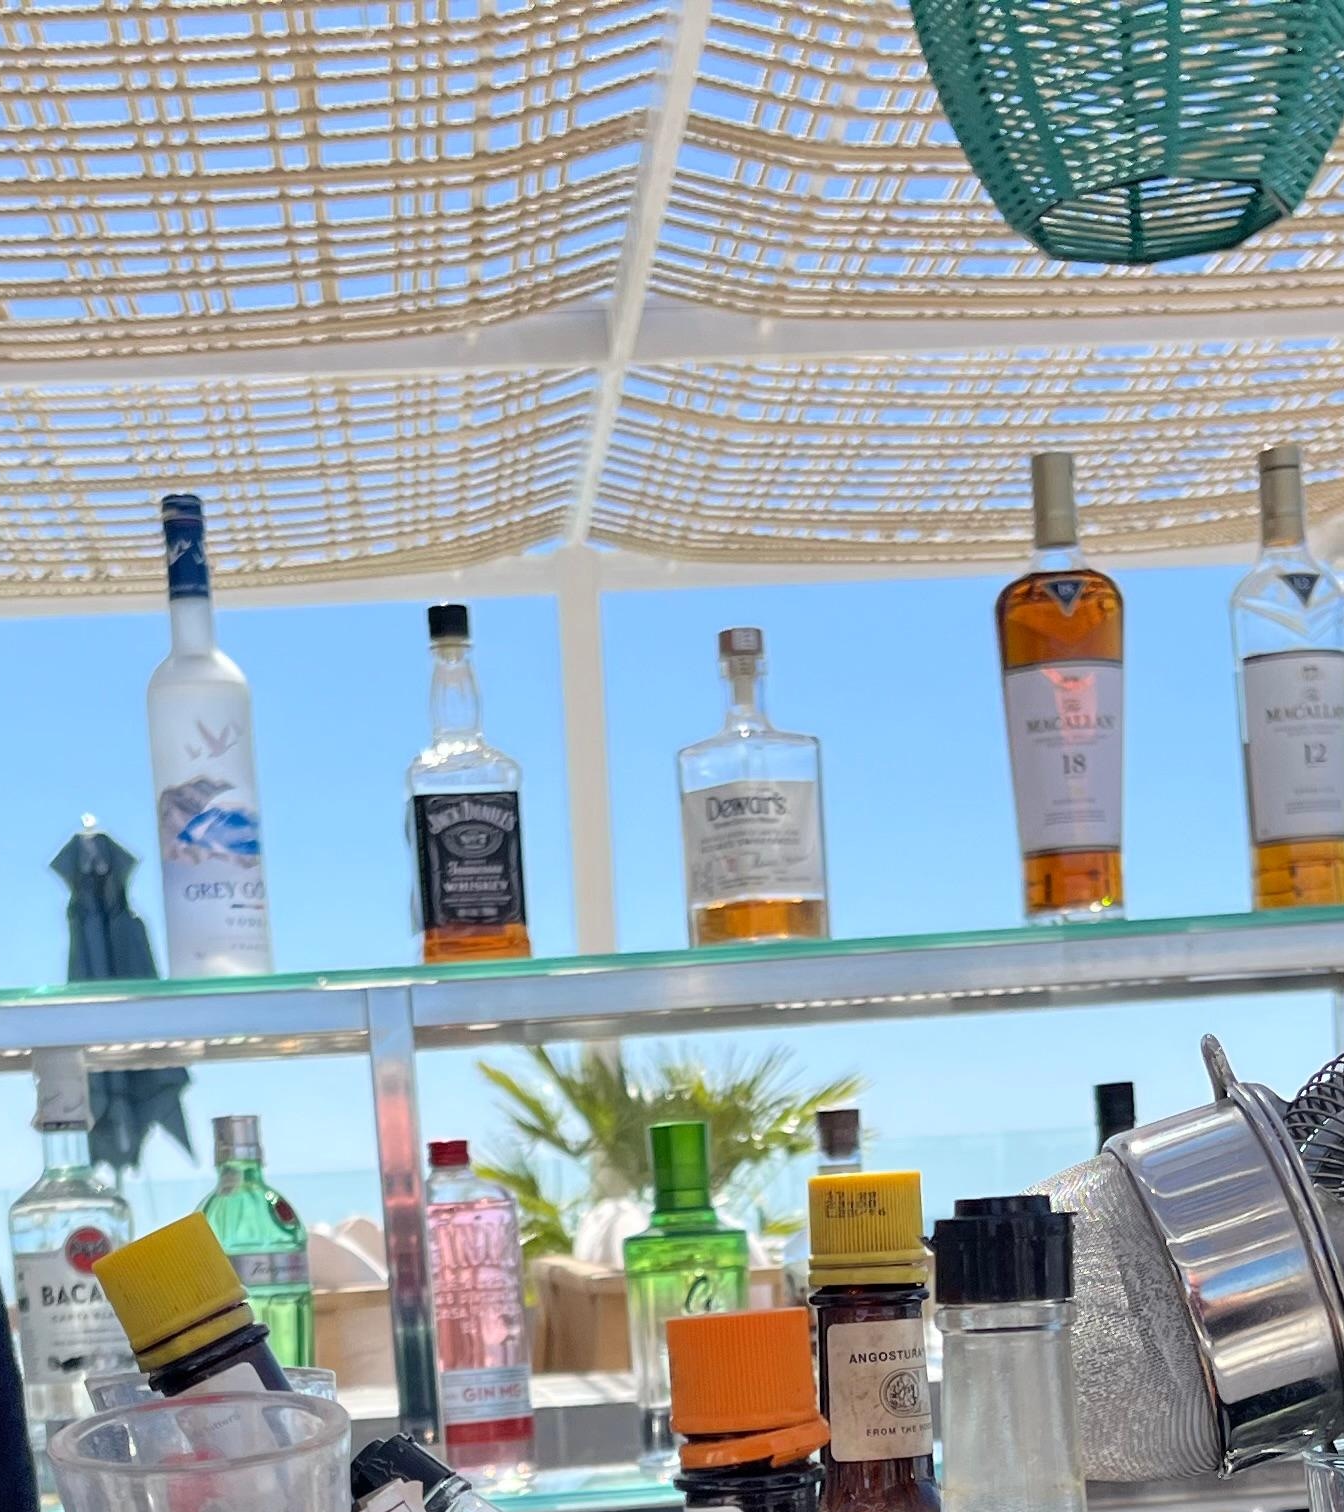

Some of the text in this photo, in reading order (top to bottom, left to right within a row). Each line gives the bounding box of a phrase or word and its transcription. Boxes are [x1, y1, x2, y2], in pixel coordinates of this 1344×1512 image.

[1062, 754, 1087, 775] 18
[1304, 744, 1327, 765] 12
[706, 792, 787, 822] Dewar's
[185, 881, 236, 902] GREY
[40, 1281, 104, 1306] BACA
[463, 1386, 496, 1402] GIN
[866, 1427, 897, 1437] FROM
[901, 1425, 918, 1435] THE
